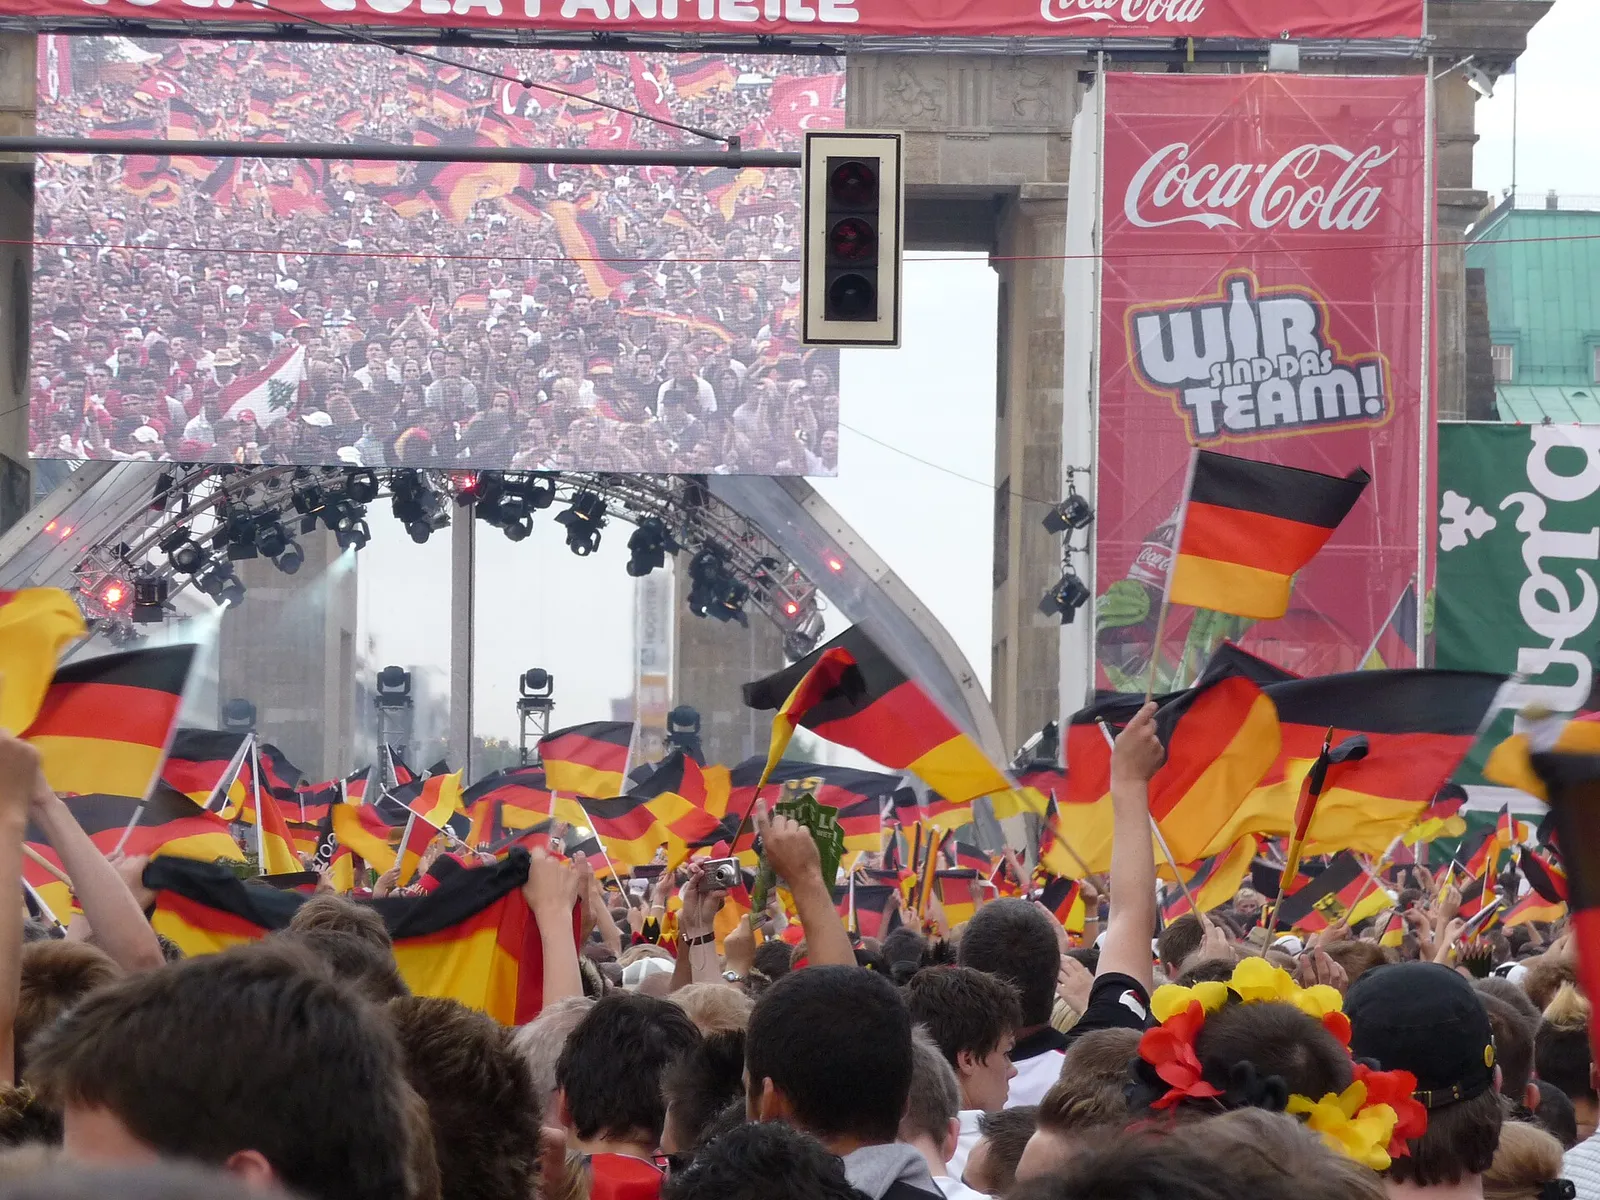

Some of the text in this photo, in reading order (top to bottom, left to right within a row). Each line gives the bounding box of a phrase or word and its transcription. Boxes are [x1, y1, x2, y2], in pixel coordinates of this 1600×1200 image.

[1123, 141, 1400, 231] Coca-Cola
[1137, 281, 1320, 384] WIR
[1209, 350, 1332, 388] SIND DAS
[1184, 364, 1381, 435] TEAM!
